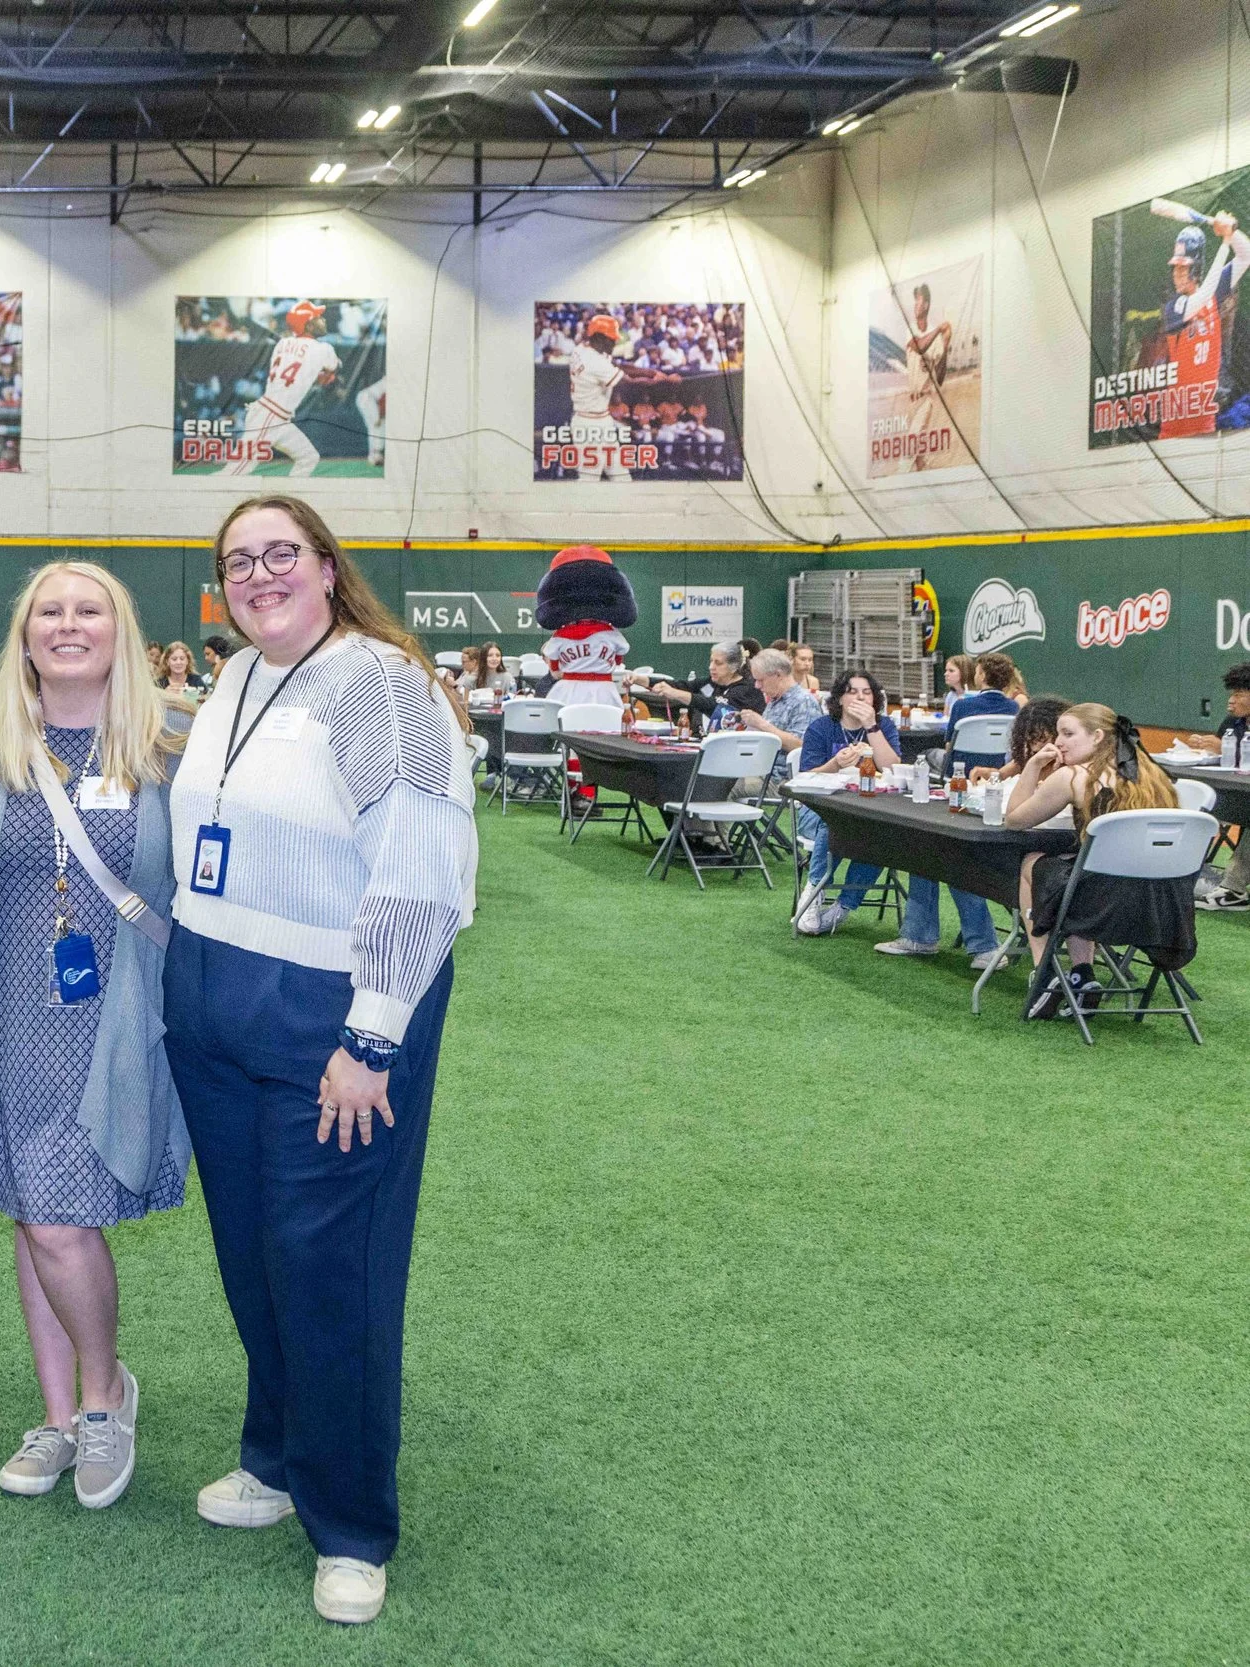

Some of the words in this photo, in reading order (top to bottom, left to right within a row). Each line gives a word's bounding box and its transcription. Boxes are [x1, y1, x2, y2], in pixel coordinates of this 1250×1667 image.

[1094, 361, 1179, 399] DESTINEE
[1093, 380, 1219, 433] MARTINEZ
[183, 419, 233, 437] ERIC
[543, 425, 631, 443] GEORGE
[872, 415, 910, 436] FRANK
[182, 438, 273, 462] DAVIS
[541, 444, 659, 470] FOSTER
[871, 428, 951, 463] ROBINSON
[688, 595, 738, 608] TriHealth
[413, 607, 468, 629] MSA
[971, 602, 1026, 643] Charmin
[1077, 588, 1171, 649] bounce
[667, 623, 714, 638] BEACON
